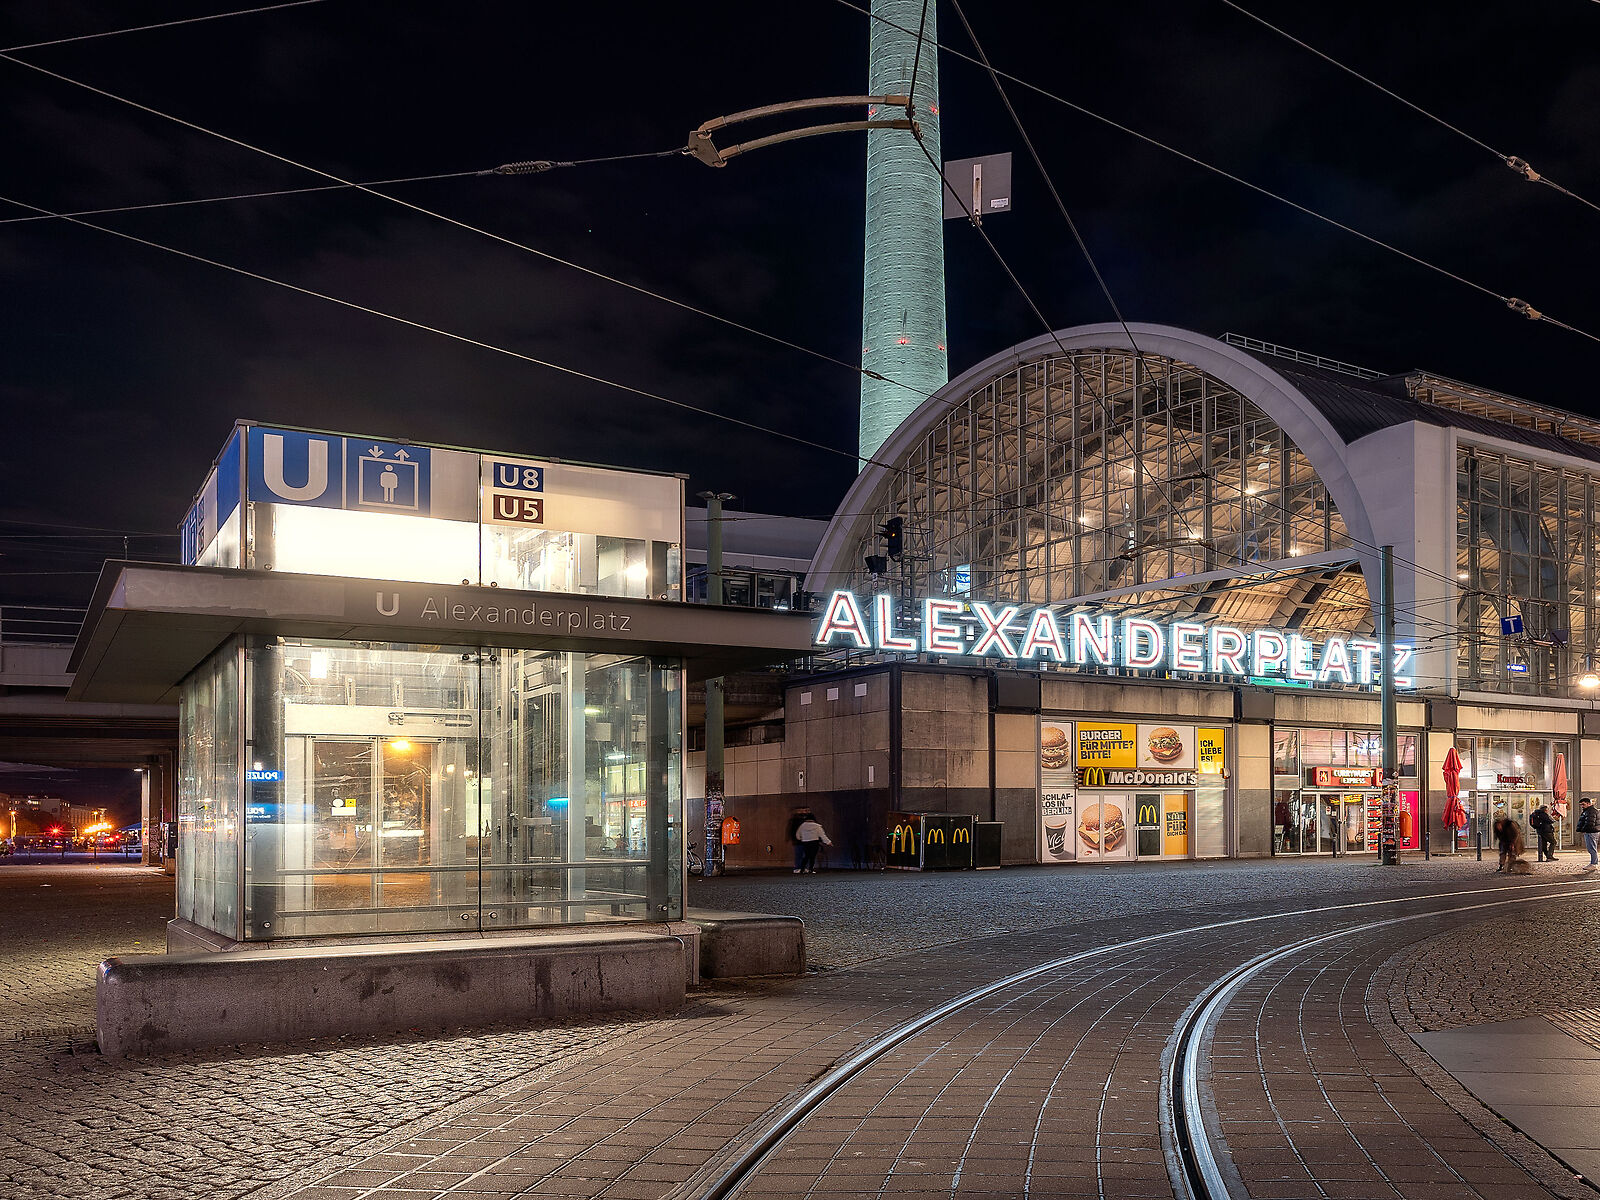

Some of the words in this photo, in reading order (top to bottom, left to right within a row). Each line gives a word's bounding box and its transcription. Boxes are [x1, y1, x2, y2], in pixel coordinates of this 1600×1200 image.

[263, 434, 329, 501] U
[500, 466, 539, 488] U8
[500, 498, 539, 520] U5
[376, 592, 400, 617] U
[421, 597, 632, 633] Alexanderplatz
[1505, 617, 1518, 633] T
[815, 590, 1413, 687] ALEXANDERPLATZ
[1080, 731, 1121, 740] BURGER
[1100, 741, 1134, 749] MITTE?
[1200, 747, 1222, 755] LIEBE
[1080, 750, 1111, 760] BITTE!
[1108, 772, 1198, 785] McDonald's
